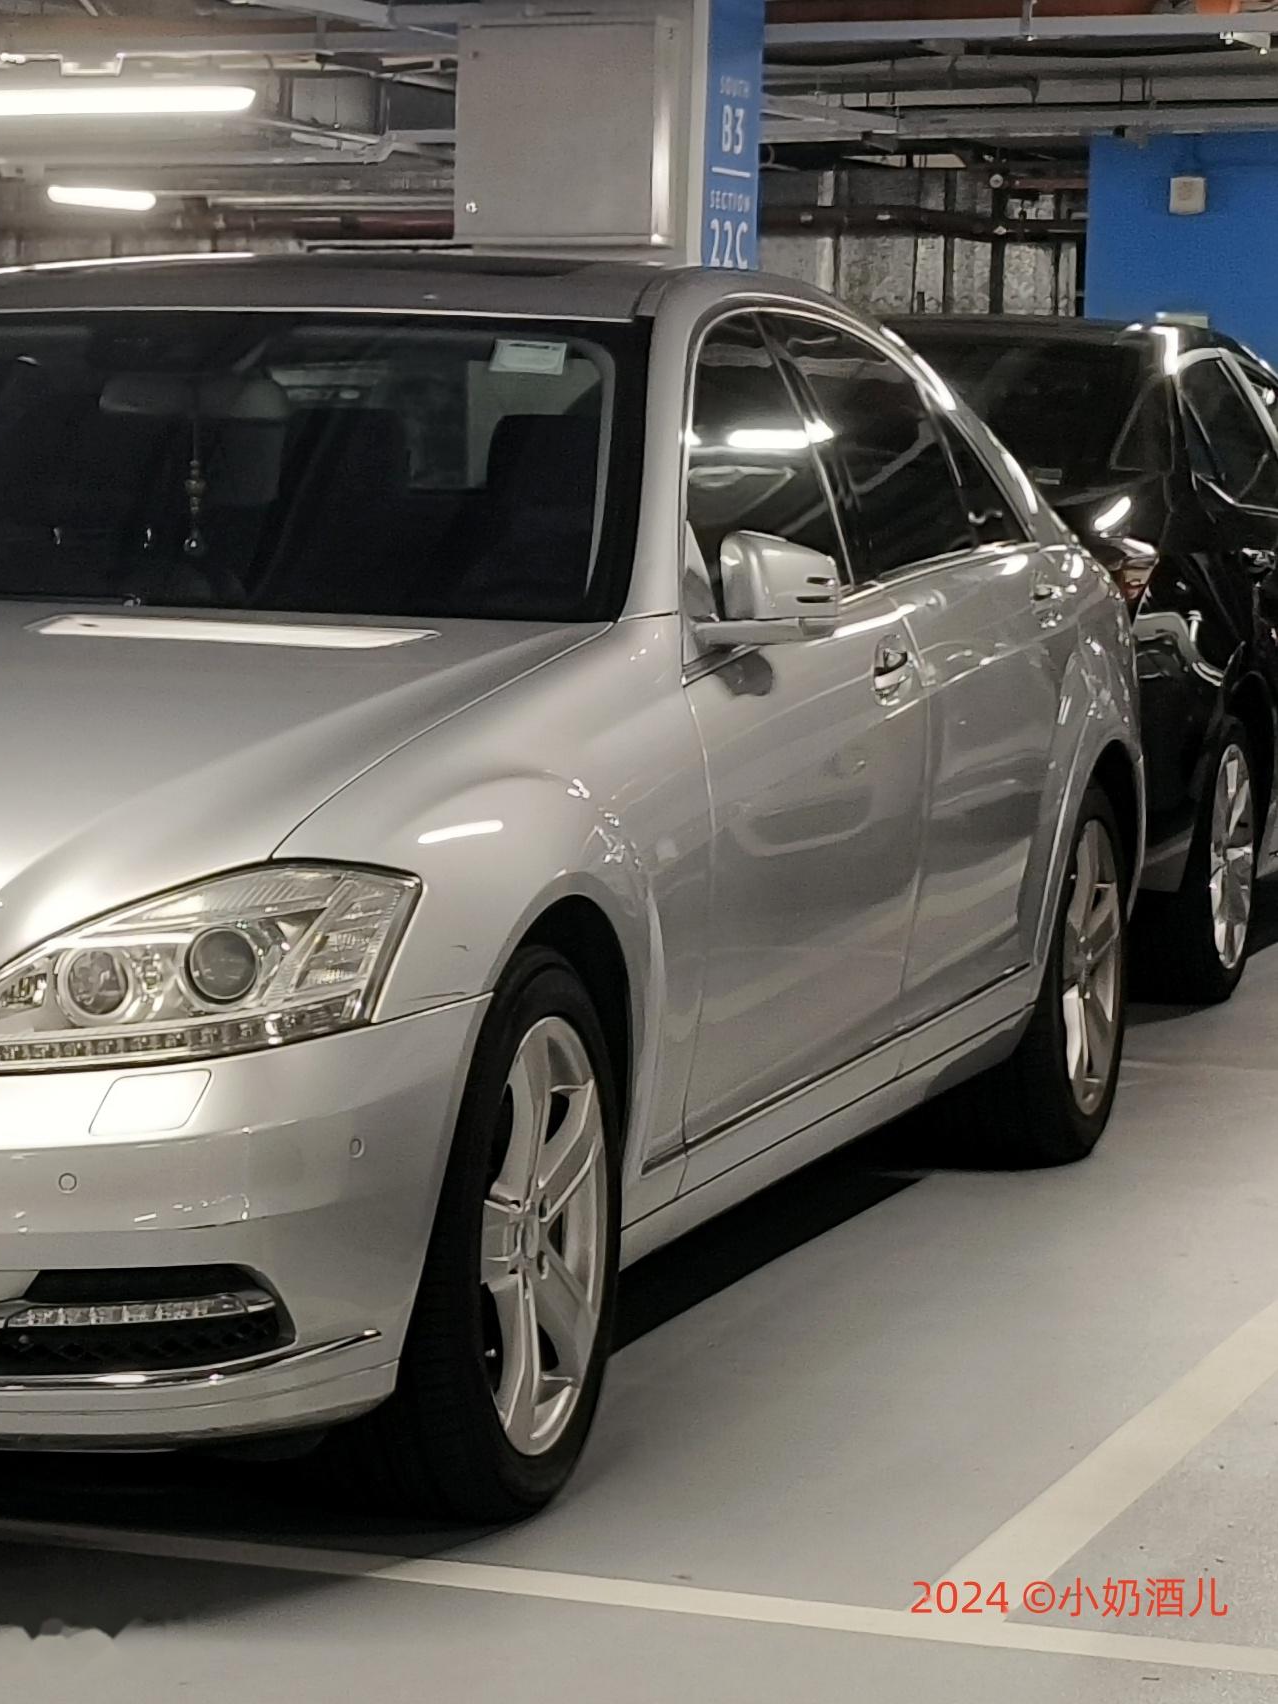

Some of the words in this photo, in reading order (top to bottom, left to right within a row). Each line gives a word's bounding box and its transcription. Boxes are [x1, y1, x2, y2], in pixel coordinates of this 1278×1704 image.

[721, 104, 745, 155] B3
[709, 189, 751, 213] SECTION
[709, 218, 749, 270] 22C
